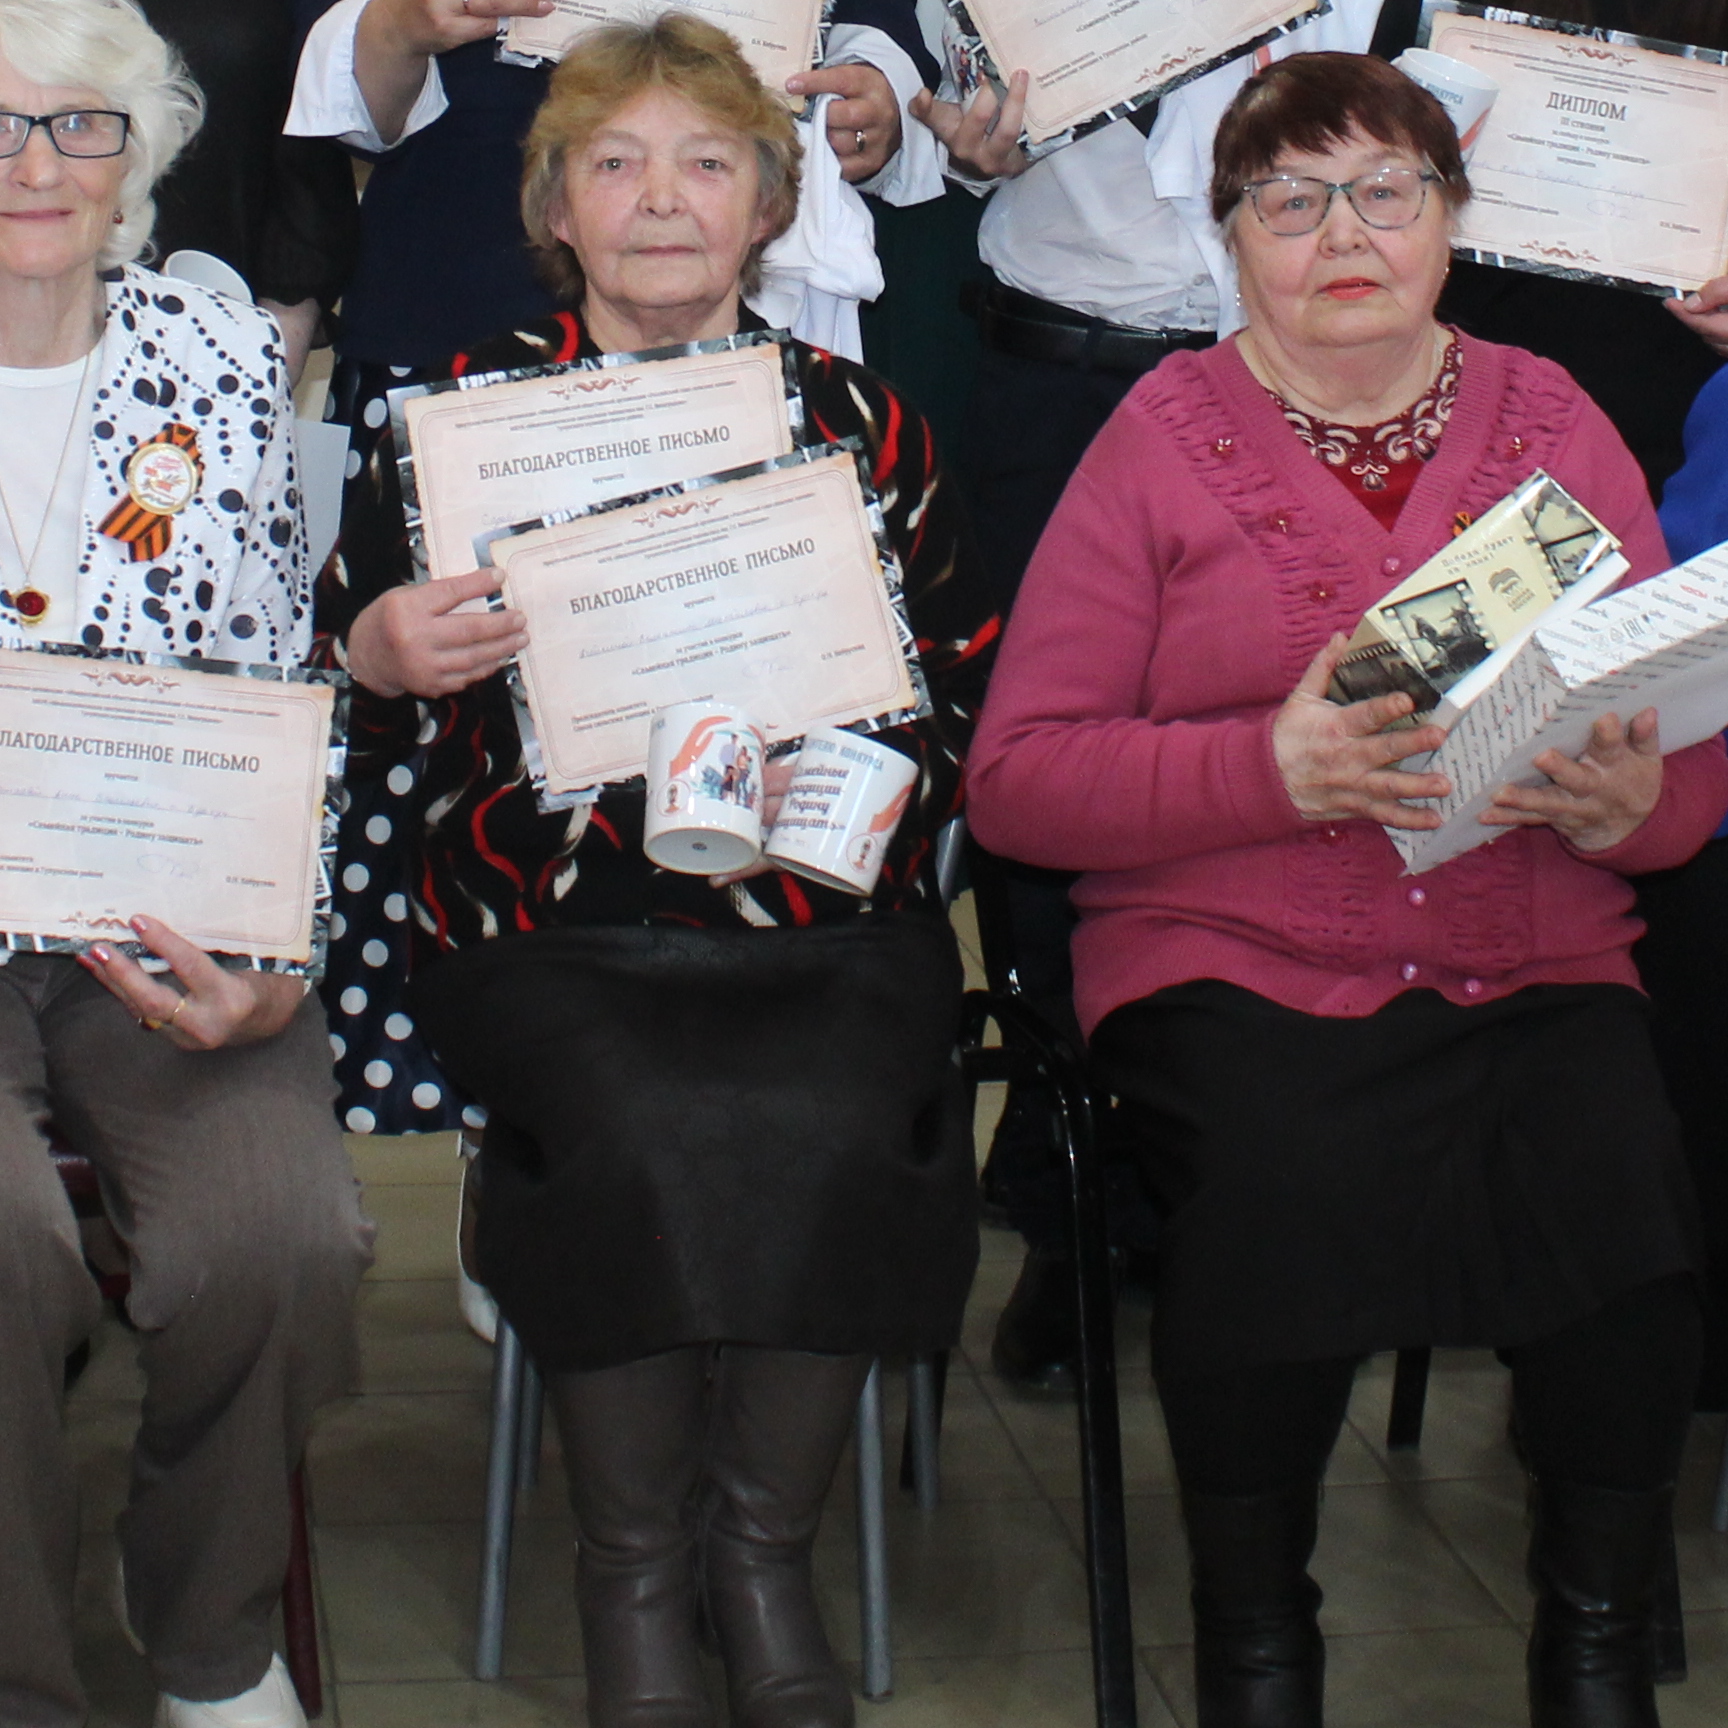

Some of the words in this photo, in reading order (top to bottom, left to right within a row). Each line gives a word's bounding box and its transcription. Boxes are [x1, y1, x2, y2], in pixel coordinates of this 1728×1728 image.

[1544, 91, 1628, 122] ДИПЛОМ
[477, 437, 651, 480] БЛАГОДАРСТВЕННОЕ
[657, 424, 731, 451] ПИСЬМО
[568, 556, 740, 616] БЛАГОДАРСТВЕННОЕ
[743, 536, 817, 570] ПИСЬМО
[182, 748, 260, 773] ПИСЬМО
